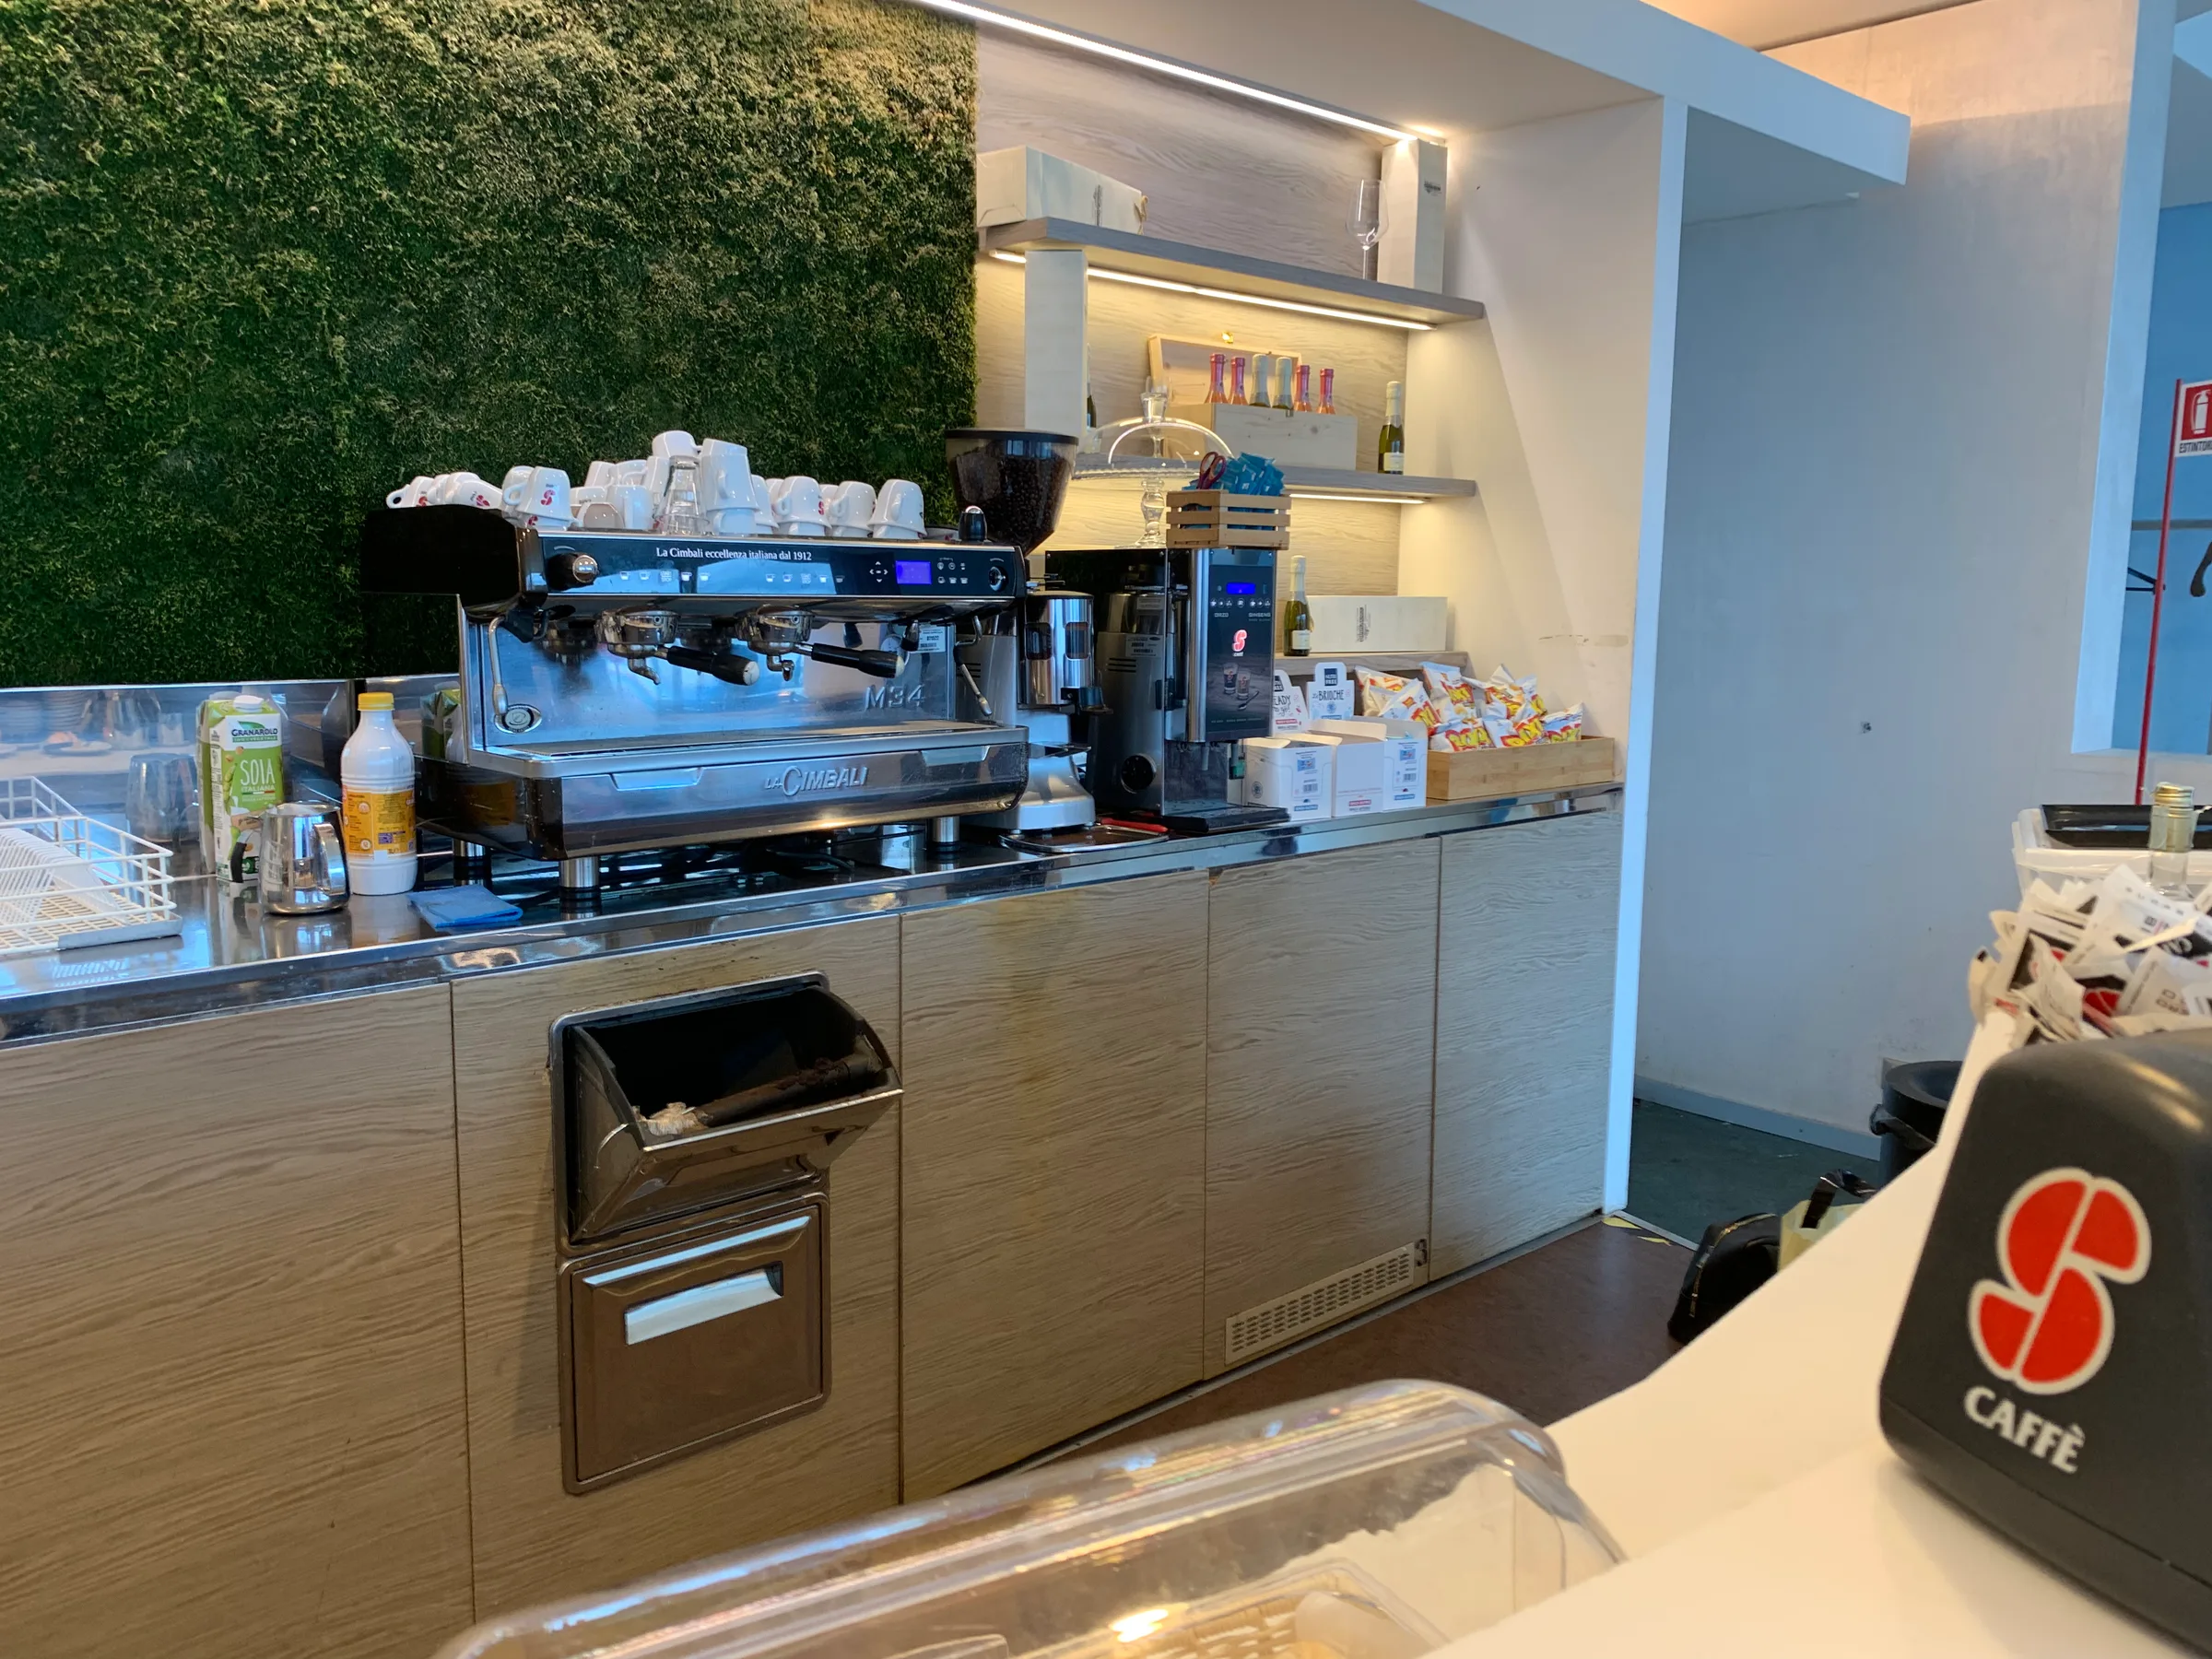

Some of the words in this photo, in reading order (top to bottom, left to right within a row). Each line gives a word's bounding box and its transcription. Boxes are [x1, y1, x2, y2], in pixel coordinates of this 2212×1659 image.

[656, 547, 668, 558] La
[669, 547, 703, 559] Cimbali
[705, 548, 747, 559] eccellenza
[749, 550, 778, 559] italiana
[779, 550, 791, 560] dal
[794, 551, 812, 560] 1912
[865, 683, 925, 712] M34
[231, 728, 278, 736] GRANAROLO
[241, 759, 276, 785] SOIA
[765, 777, 782, 790] LA
[782, 765, 870, 796] CIMBALI
[1962, 1384, 2087, 1474] CAFFÈ
